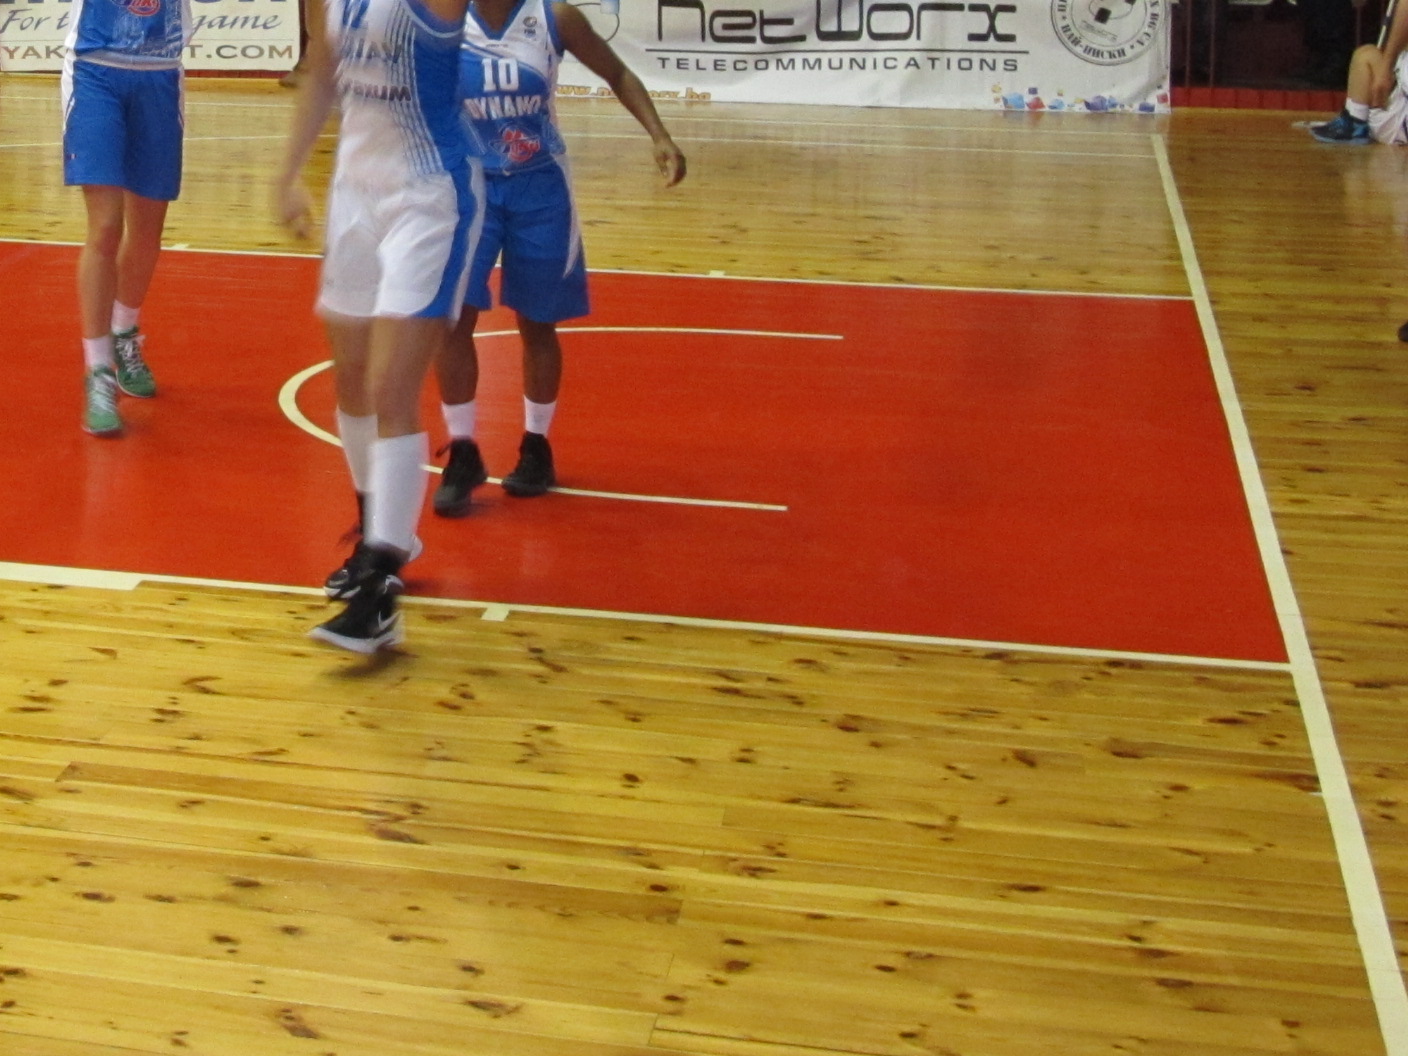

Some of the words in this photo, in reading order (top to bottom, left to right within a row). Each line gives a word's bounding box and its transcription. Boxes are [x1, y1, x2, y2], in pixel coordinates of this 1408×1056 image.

[0, 9, 51, 34] For
[482, 56, 519, 93] 10
[657, 57, 1018, 71] TELECOMMUNICATIONS
